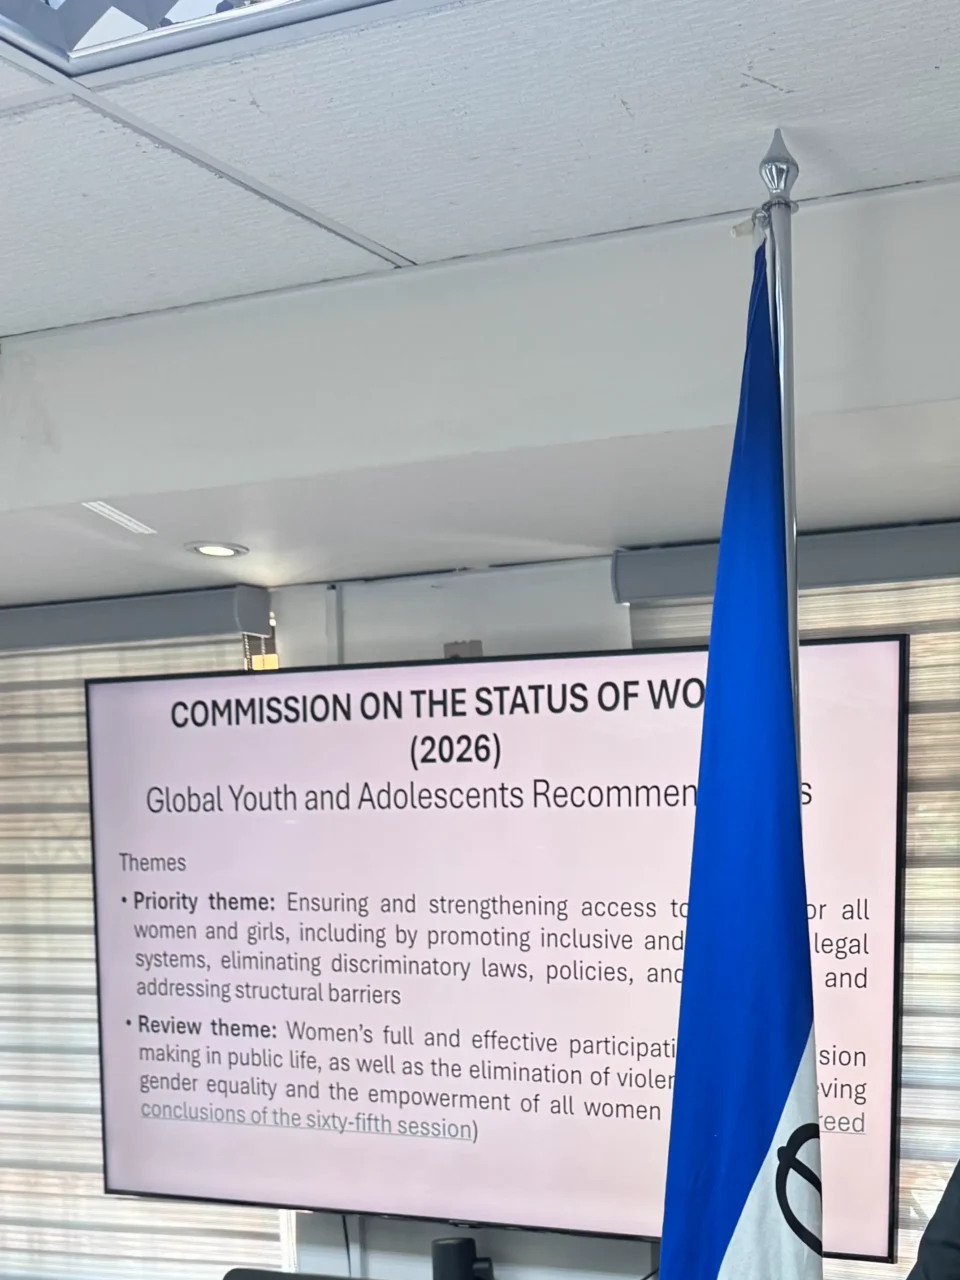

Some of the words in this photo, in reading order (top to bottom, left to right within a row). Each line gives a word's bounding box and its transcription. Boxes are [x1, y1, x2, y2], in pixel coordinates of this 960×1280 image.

[171, 693, 351, 728] COMMISSION
[360, 690, 402, 720] ON
[411, 688, 467, 718] THE
[474, 682, 588, 716] STATUS
[597, 680, 640, 711] OF
[409, 732, 502, 771] (2026)
[146, 785, 223, 813] Global
[229, 783, 297, 812] Youth
[304, 782, 350, 811] and
[358, 779, 524, 810] Adolescents
[119, 852, 186, 872] Themes
[132, 891, 198, 915] Priority
[208, 892, 275, 912] theme:
[287, 892, 369, 917] Ensuring
[380, 894, 416, 914] and
[429, 895, 569, 921] strengthening
[581, 900, 657, 917] access
[807, 903, 827, 920] or
[842, 898, 870, 920] all
[134, 924, 197, 941] women
[205, 922, 238, 941] and
[247, 923, 290, 945] girls,
[299, 923, 386, 948] including
[395, 925, 418, 948] by
[427, 927, 531, 952] promoting
[541, 928, 633, 950] inclusive
[644, 931, 684, 951] and
[814, 933, 869, 959] legal
[135, 951, 211, 972] systems,
[221, 952, 321, 976] eliminating
[331, 954, 471, 981] discriminatory
[482, 958, 533, 982] laws,
[546, 961, 634, 985] policies,
[825, 967, 868, 988] and
[136, 977, 231, 1002] addressing
[235, 980, 323, 1002] structural
[328, 983, 401, 1005] barriers
[138, 1014, 202, 1035] Review
[210, 1017, 277, 1038] theme:
[382, 1025, 414, 1046] full
[424, 1028, 461, 1049] and
[472, 1029, 558, 1053] effective
[569, 1034, 676, 1061] participati
[819, 1045, 866, 1067] sion
[139, 1044, 201, 1067] making
[206, 1046, 221, 1065] in
[228, 1048, 283, 1070] public
[290, 1050, 322, 1073] life,
[329, 1055, 351, 1072] as
[356, 1054, 396, 1075] well
[402, 1060, 424, 1077] as
[431, 1056, 462, 1078] the
[469, 1059, 582, 1085] elimination
[590, 1065, 611, 1087] of
[140, 1072, 198, 1093] gender
[206, 1075, 277, 1100] equality
[286, 1079, 320, 1099] and
[328, 1080, 358, 1101] the
[368, 1088, 510, 1111] empowerment
[520, 1092, 540, 1113] of
[550, 1095, 575, 1115] all
[584, 1102, 661, 1120] women
[141, 1100, 246, 1123] conclusions
[250, 1105, 272, 1125] of
[272, 1107, 301, 1127] the
[306, 1109, 391, 1134] sixty-fifth
[397, 1119, 478, 1143] session)
